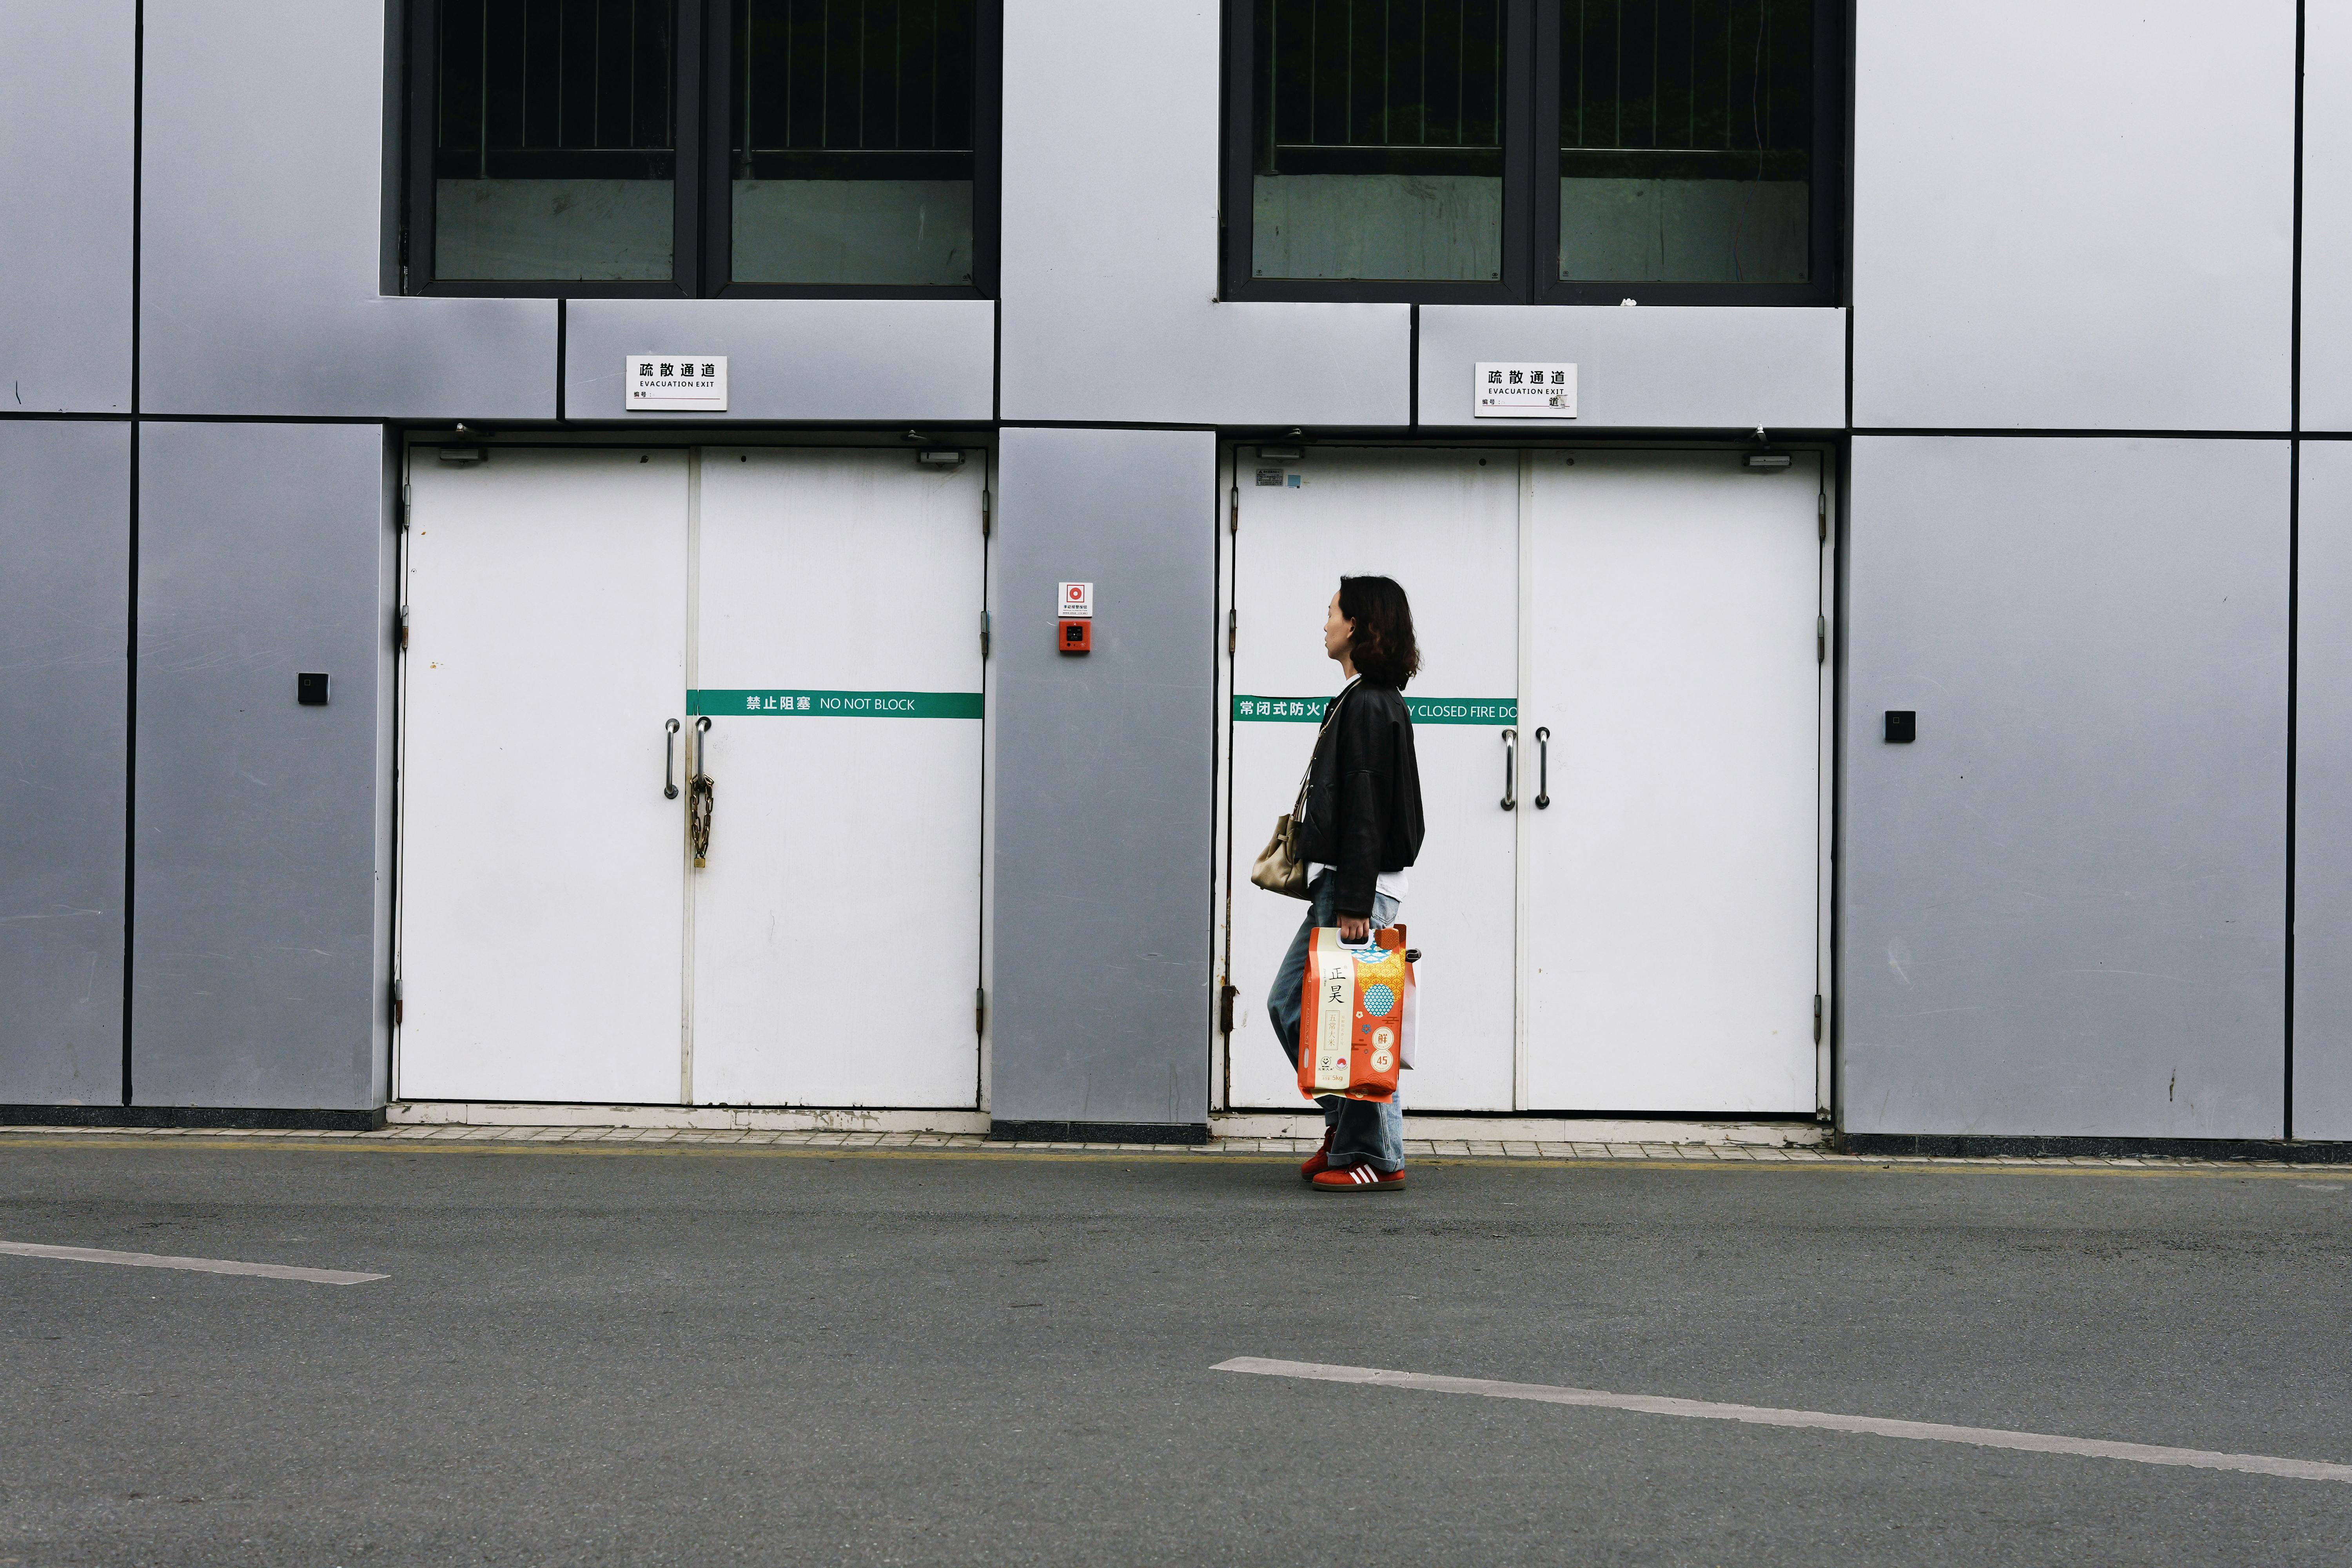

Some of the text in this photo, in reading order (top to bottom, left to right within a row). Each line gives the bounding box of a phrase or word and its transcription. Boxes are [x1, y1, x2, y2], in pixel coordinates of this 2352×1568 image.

[639, 363, 715, 377] 疏散通道
[1488, 370, 1564, 385] 疏散通道
[746, 696, 811, 710] 禁止阻塞
[820, 698, 915, 710] NO NOT BLOCK
[1418, 705, 1467, 717] CLOSED
[1470, 706, 1495, 717] FIRE
[1328, 967, 1346, 1003] 正昊
[1328, 1014, 1336, 1047] 五常大米
[1378, 1034, 1387, 1044] 鲜
[1377, 1056, 1387, 1065] 45
